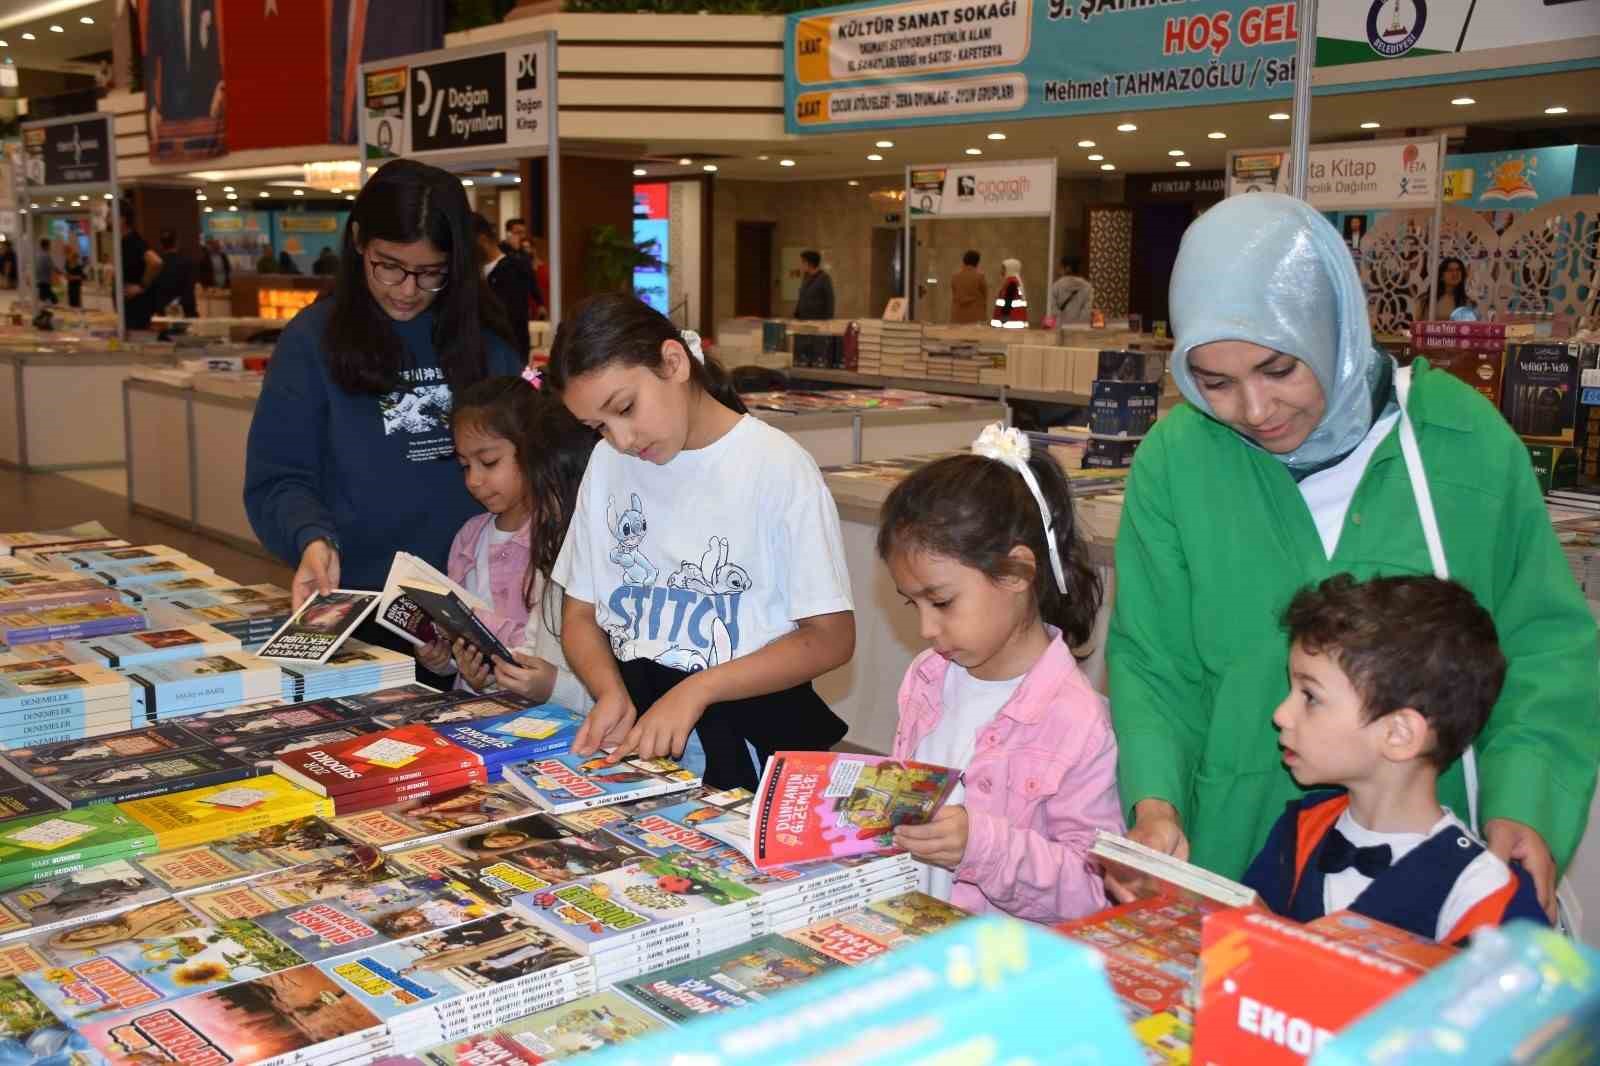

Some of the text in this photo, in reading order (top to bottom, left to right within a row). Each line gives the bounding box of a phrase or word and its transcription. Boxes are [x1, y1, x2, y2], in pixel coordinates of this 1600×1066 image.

[838, 1, 1017, 40] KÜLTÜR SANAT SOKAĞI
[1165, 13, 1231, 54] HOŞ
[1045, 78, 1109, 100] Mehmet
[1115, 62, 1245, 95] TAHMAZOĞLU
[448, 85, 489, 112] Doğan
[516, 98, 542, 113] Doğan
[516, 118, 538, 133] Kitap
[1331, 158, 1378, 180] Kitap
[608, 585, 743, 650] STITCH
[279, 635, 335, 646] MEKTUBU
[20, 692, 69, 706] DENEMELER
[23, 707, 72, 721] DENEMELER
[23, 720, 72, 735] DENEMELER
[303, 761, 332, 776] ZOR
[306, 750, 363, 780] SUDOKU
[534, 760, 604, 798] KUŞLAR
[636, 816, 721, 850] KUŞLAR
